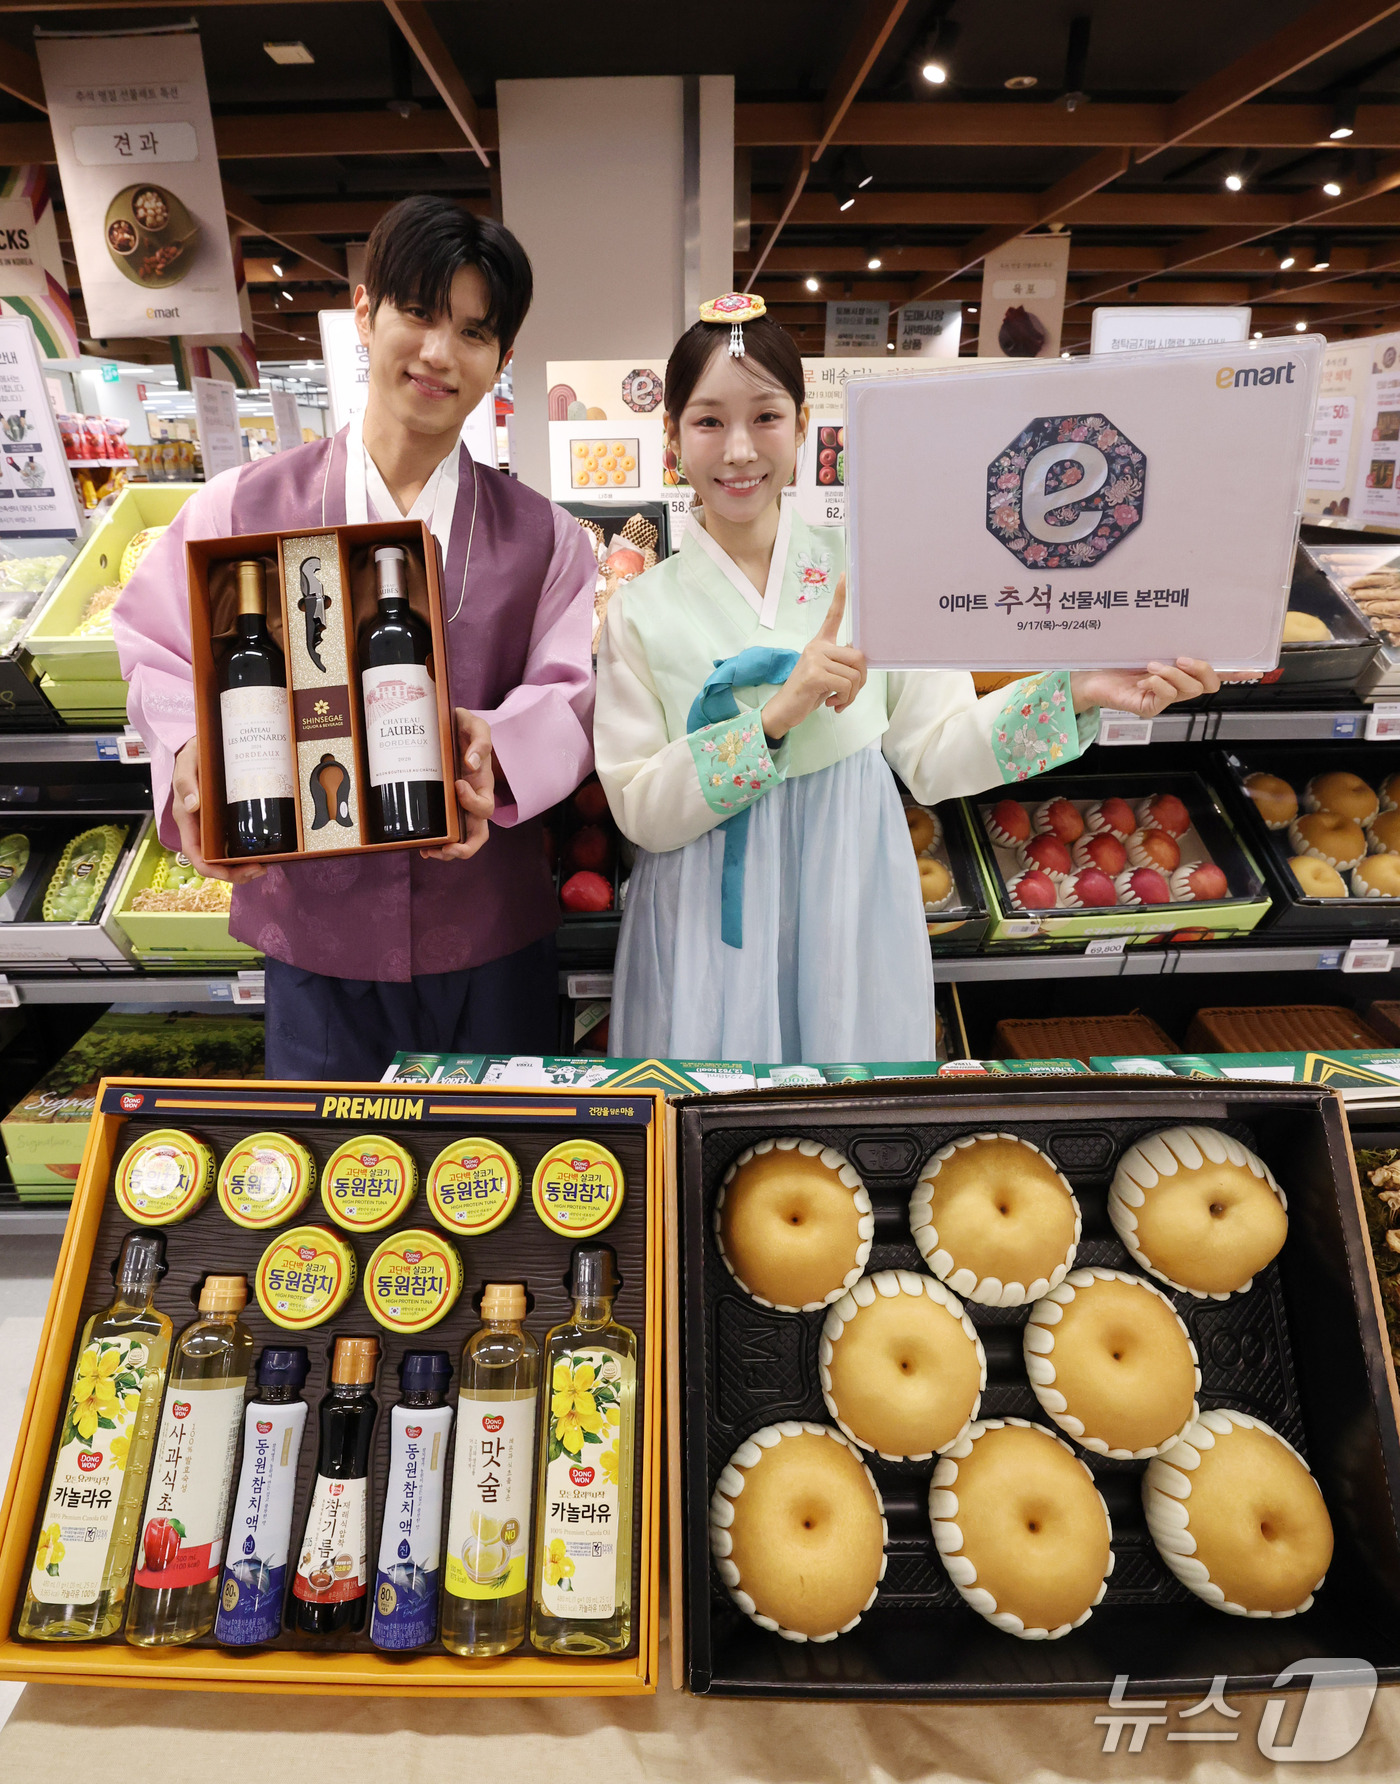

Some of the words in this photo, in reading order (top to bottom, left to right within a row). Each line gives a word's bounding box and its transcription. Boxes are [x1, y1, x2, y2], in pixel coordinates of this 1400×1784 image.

[146, 307, 180, 319] emart
[902, 338, 922, 350] 상품
[1215, 362, 1296, 389] emart
[939, 594, 988, 612] 이마트
[994, 584, 1052, 615] 추석
[1058, 590, 1129, 610] 선물세트
[1134, 588, 1189, 608] 본판매
[1017, 619, 1101, 631] 9/17(목)~9/24(목)
[302, 714, 343, 725] SHINSEGAE
[380, 723, 425, 738] LAUBÈS
[239, 733, 287, 743] MOYNARDS
[379, 738, 428, 749] BORDEAUX
[235, 750, 280, 760] BORDEAUX
[1090, 945, 1122, 954] 69,800
[123, 1096, 141, 1105] DONG
[321, 1097, 424, 1120] PREMIUM
[589, 1107, 609, 1117] 건강을
[620, 1107, 634, 1117] 마음
[346, 1168, 367, 1177] 고단백
[369, 1168, 390, 1177] 살코기
[449, 1172, 470, 1182] 고단백
[473, 1168, 494, 1179] 살코기
[556, 1172, 578, 1182] 고단백
[580, 1173, 602, 1182] 살코기
[334, 1177, 398, 1198] 동원참치
[440, 1177, 504, 1204] 동원참치
[546, 1182, 609, 1202] 동원참치
[300, 1248, 315, 1256] DONG
[281, 1259, 304, 1271] 고단백
[305, 1263, 326, 1273] 살코기
[388, 1265, 411, 1275] 고단백
[412, 1265, 434, 1275] 살코기
[268, 1268, 333, 1294] 동원참치
[377, 1275, 442, 1297] 동원참치
[157, 1423, 186, 1511] 사과식초
[477, 1437, 505, 1503] 맛술
[245, 1438, 270, 1533] 동원참치액
[399, 1444, 419, 1537] 동원참치액
[53, 1487, 112, 1509] 카놀라유
[551, 1502, 611, 1524] 카놀라유
[318, 1498, 342, 1559] 참기름
[505, 1530, 516, 1541] NO
[400, 1545, 409, 1556] 진
